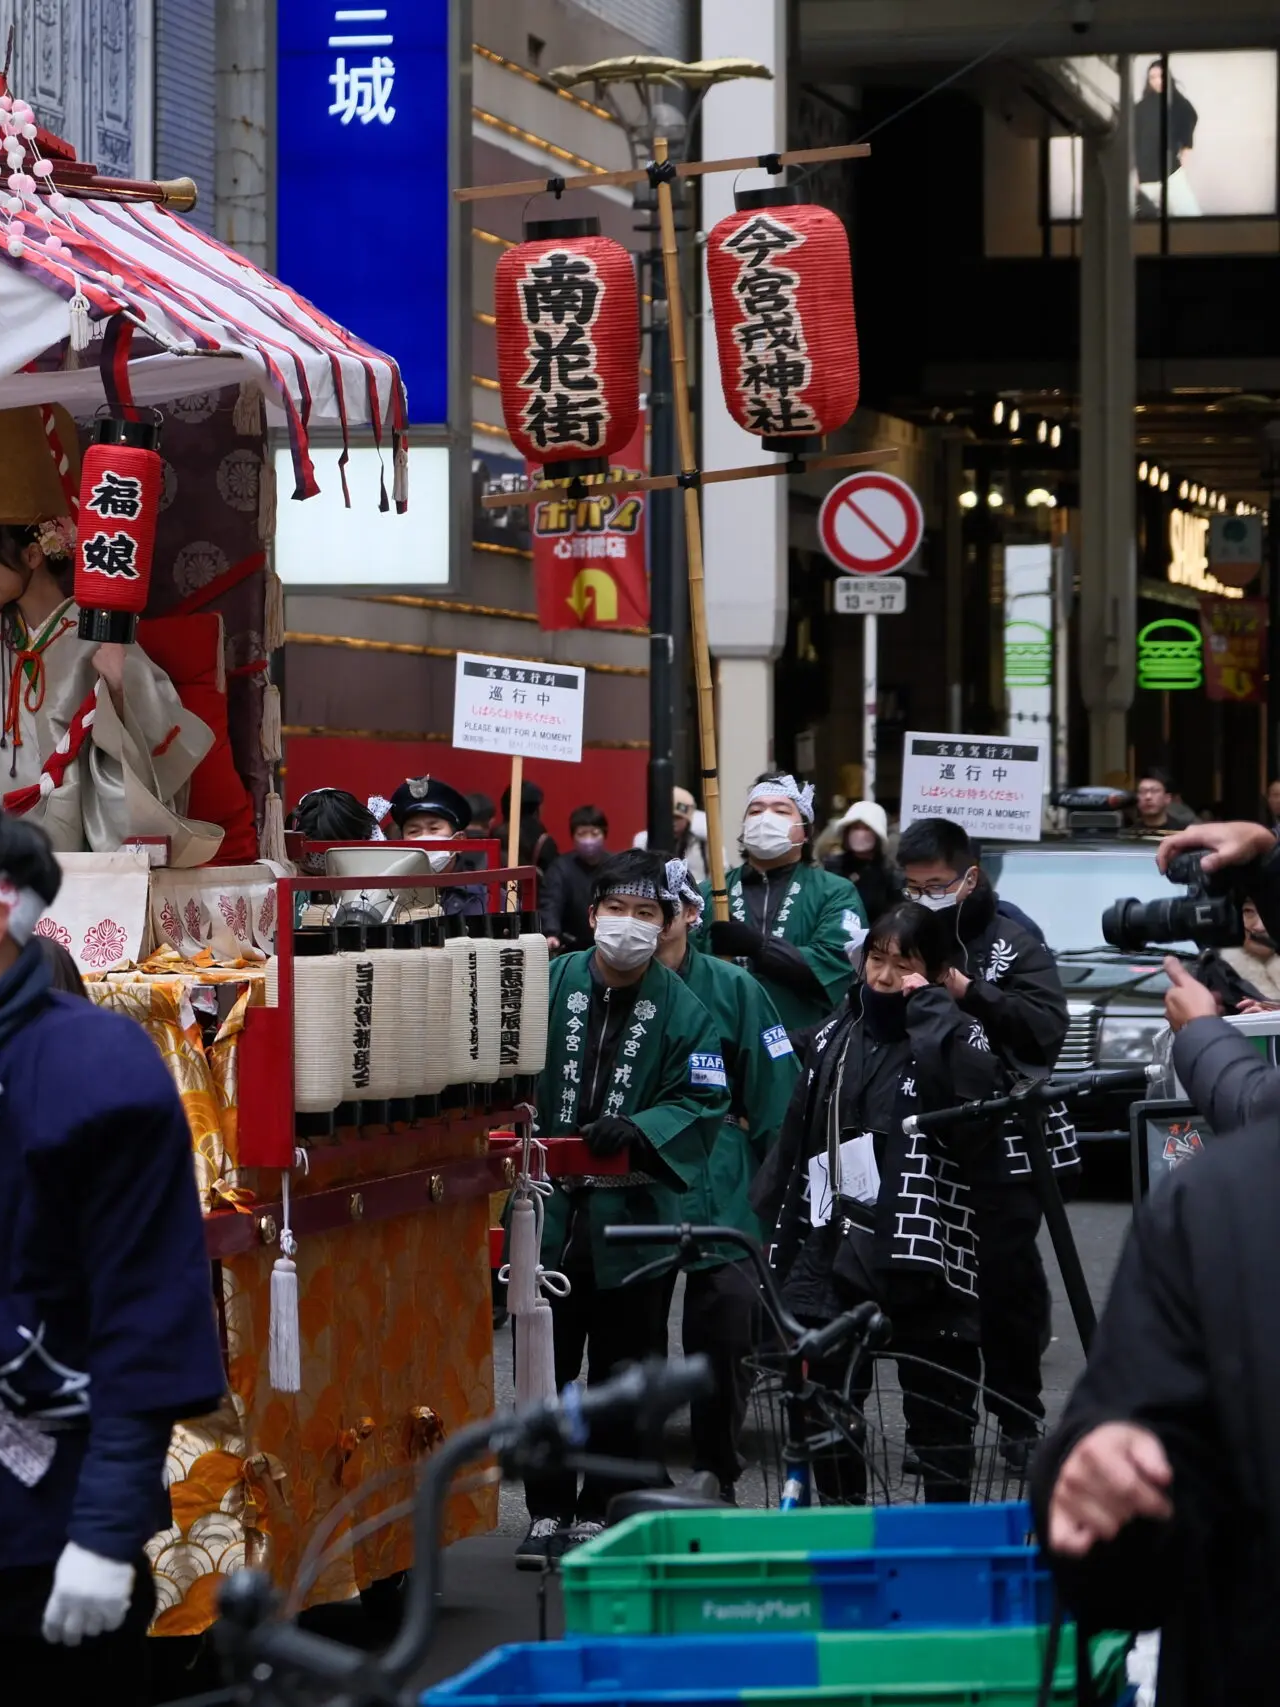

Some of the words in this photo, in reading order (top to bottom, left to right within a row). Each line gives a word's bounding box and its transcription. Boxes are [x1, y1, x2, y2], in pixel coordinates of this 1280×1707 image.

[723, 214, 819, 436] 今宮戎神社
[86, 471, 143, 580] 福娘
[535, 497, 642, 535] ポパイ
[488, 685, 551, 707] 巡行中
[471, 704, 567, 725] しばらくお待ちください
[464, 721, 492, 732] PLEASE
[495, 725, 512, 735] WAIT
[514, 728, 530, 737] FOR
[531, 730, 538, 738] A
[539, 731, 572, 742] MOMENT
[938, 762, 1008, 783] 巡行中
[920, 785, 1024, 802] しばらくお待ちください
[912, 804, 943, 814] PLEASE
[945, 806, 965, 815] WAIT
[967, 808, 985, 817] FOR
[986, 809, 993, 817] A
[994, 810, 1032, 819] MOMENT
